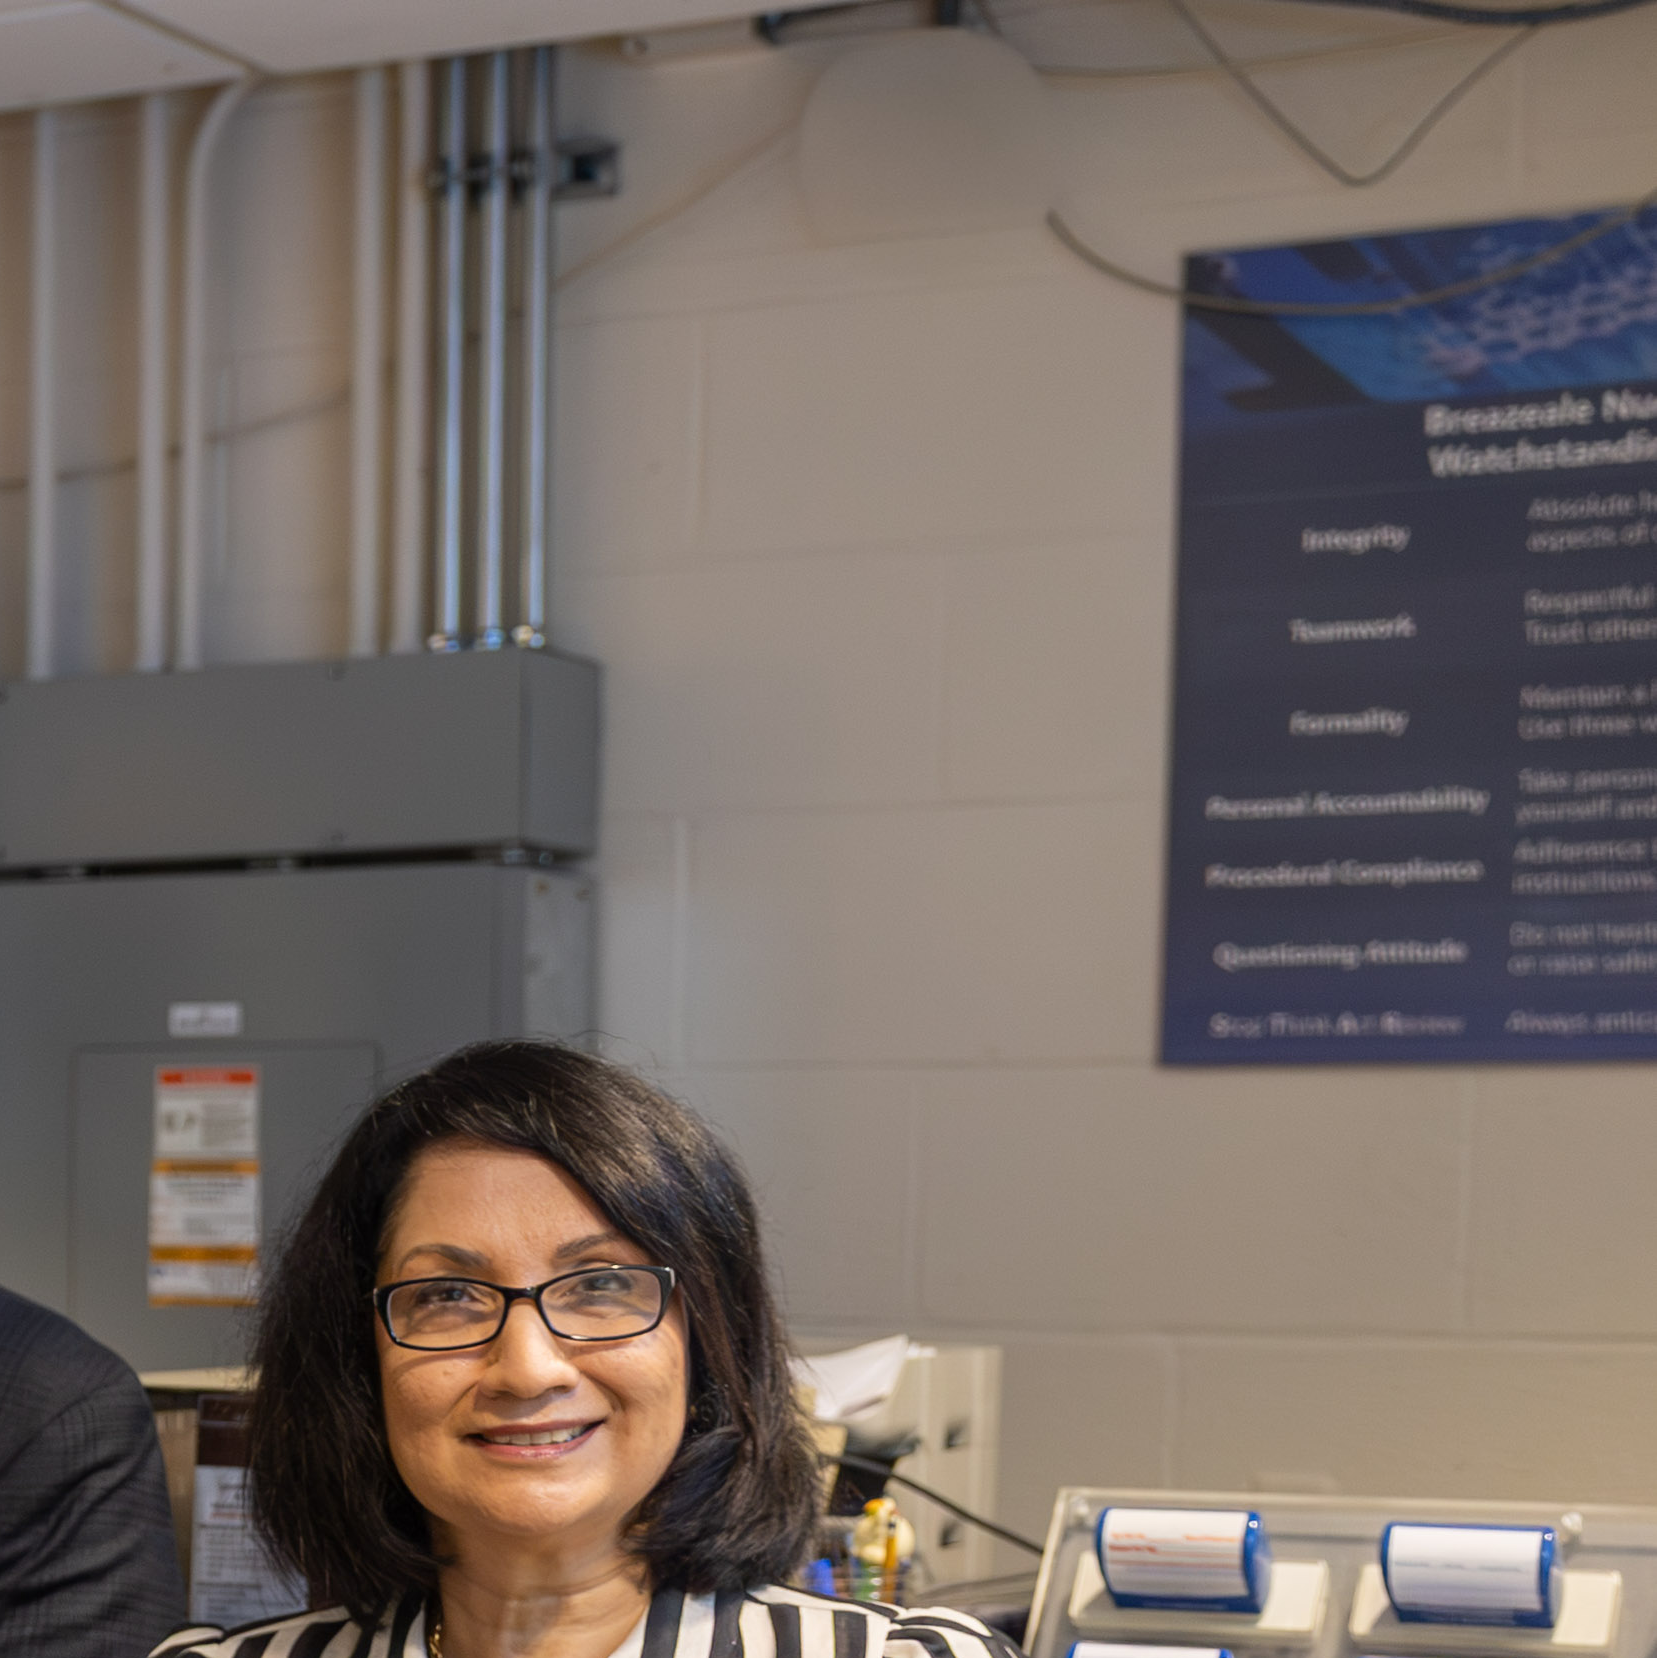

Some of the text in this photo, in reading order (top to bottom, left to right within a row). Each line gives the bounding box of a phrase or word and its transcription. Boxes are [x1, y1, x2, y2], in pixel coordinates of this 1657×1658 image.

[1424, 391, 1596, 438] Breazeale
[1301, 523, 1412, 555] Integrity
[1288, 612, 1417, 645] Teamwork
[1289, 706, 1410, 737] Formality
[1204, 784, 1491, 821] Personal Accountability
[1204, 857, 1484, 890] Procedural Compliance
[1213, 937, 1469, 972] Questioning Attitude
